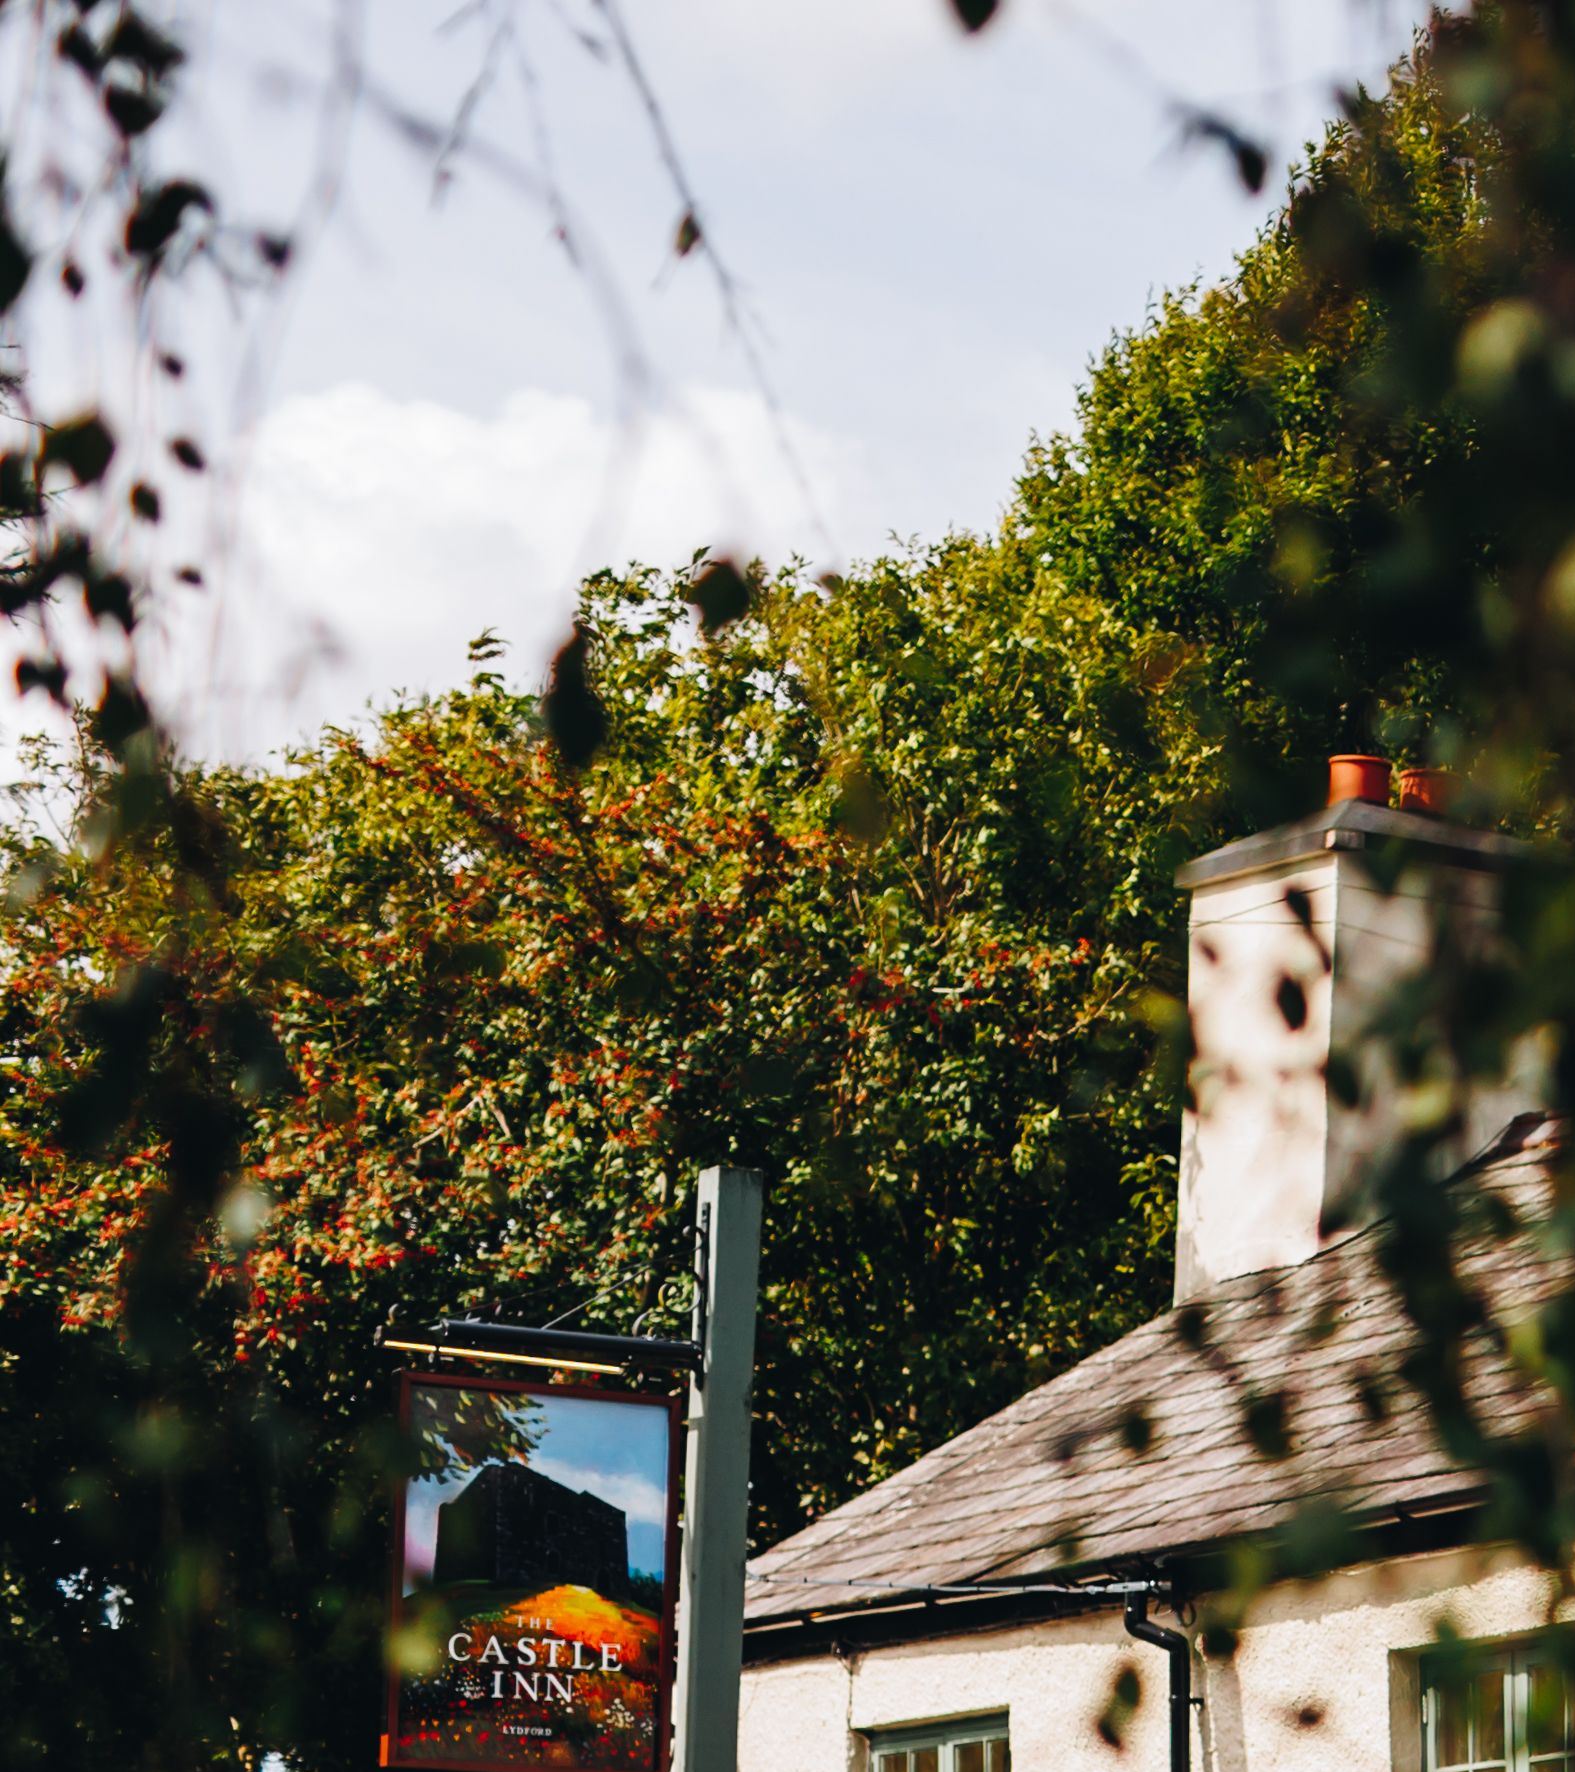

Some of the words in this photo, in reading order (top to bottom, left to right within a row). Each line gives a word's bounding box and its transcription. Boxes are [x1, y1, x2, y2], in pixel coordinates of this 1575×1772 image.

[514, 1614, 554, 1631] THE
[447, 1632, 623, 1672] CASTLE
[491, 1670, 575, 1703] INN
[502, 1724, 553, 1737] LYDFORD
